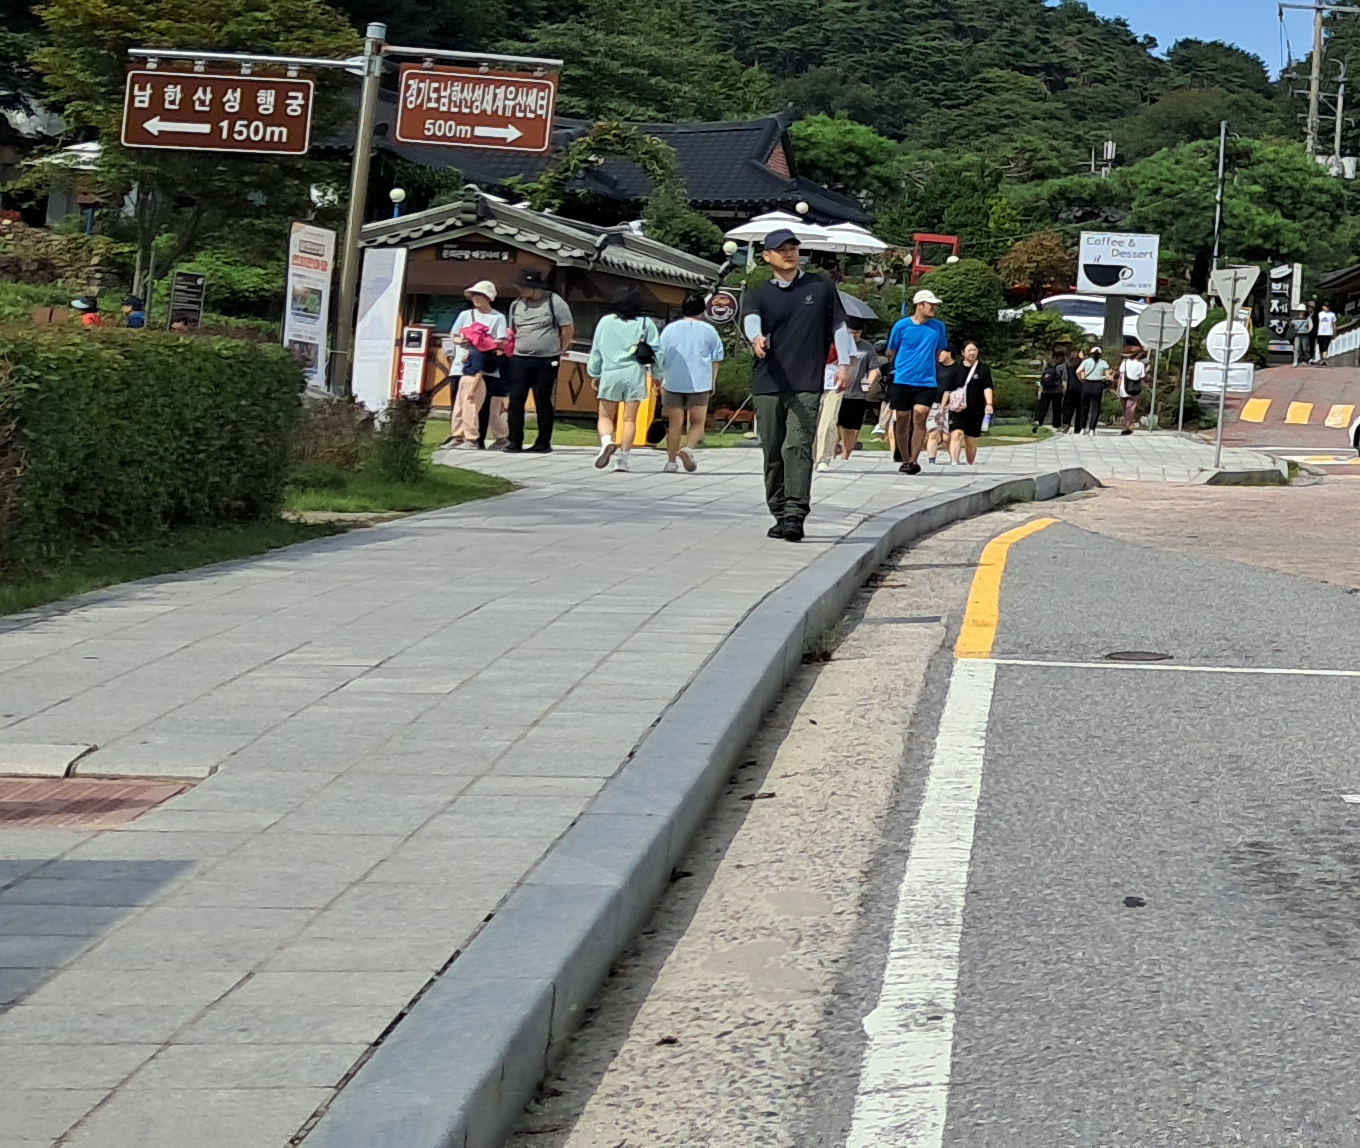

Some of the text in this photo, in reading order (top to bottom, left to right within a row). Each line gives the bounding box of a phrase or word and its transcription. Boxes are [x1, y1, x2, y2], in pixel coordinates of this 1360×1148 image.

[133, 83, 305, 116] 남한산성 행궁
[406, 78, 549, 119] 경기도남한산성세계유산센터
[218, 119, 288, 142] 150m
[423, 119, 471, 139] 500m
[1086, 236, 1136, 248] Coffee &
[1111, 248, 1154, 260] Dessert
